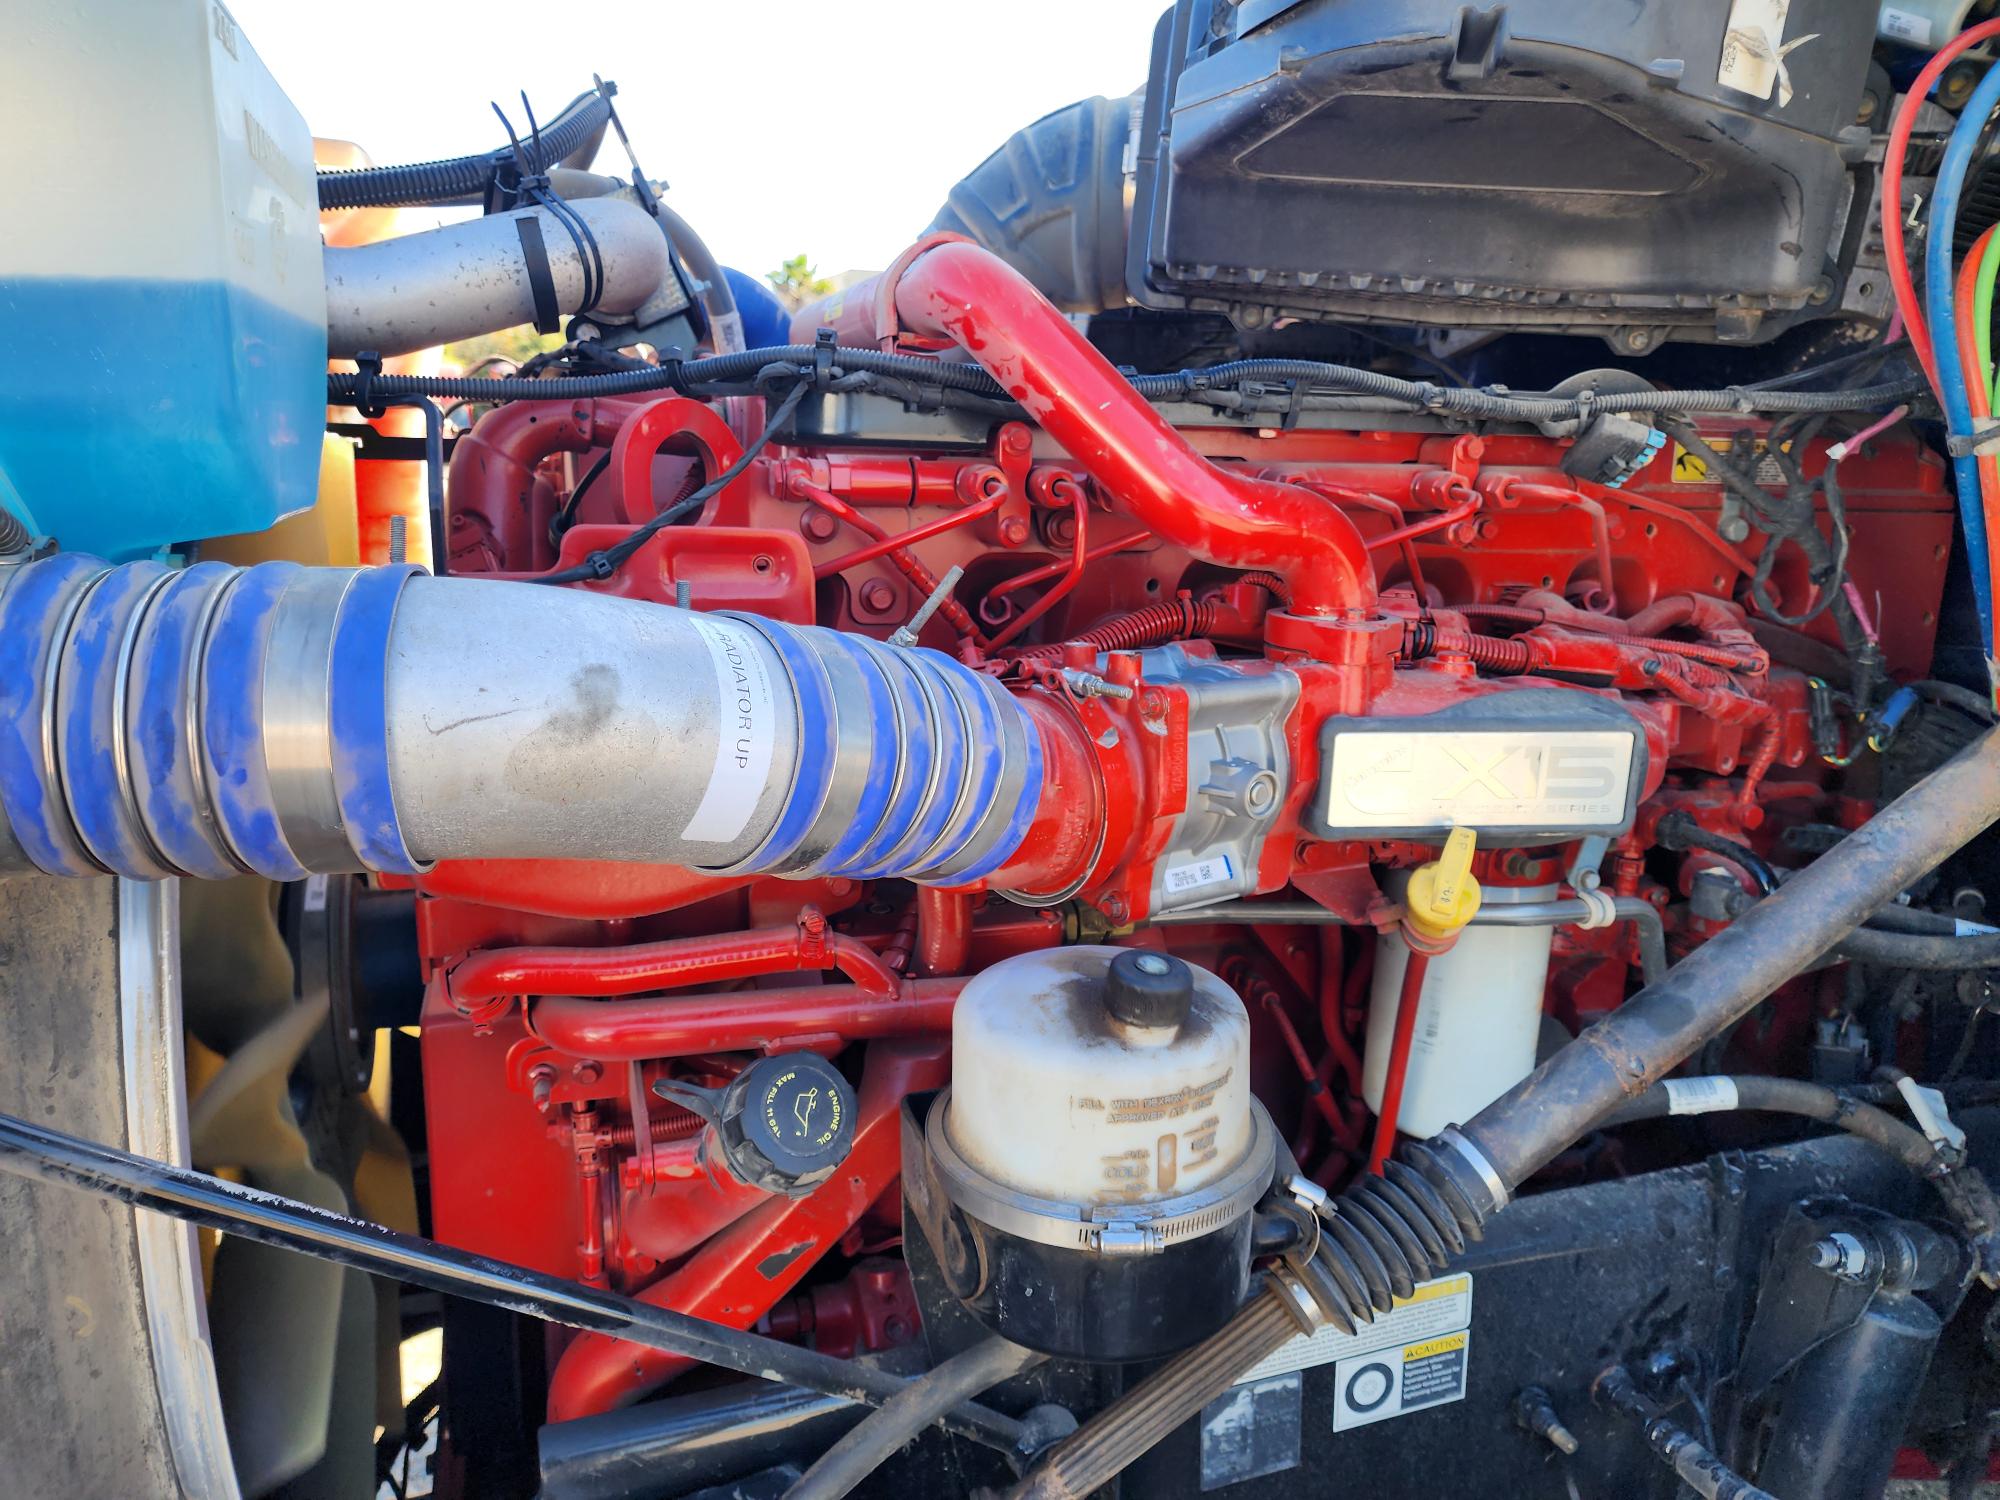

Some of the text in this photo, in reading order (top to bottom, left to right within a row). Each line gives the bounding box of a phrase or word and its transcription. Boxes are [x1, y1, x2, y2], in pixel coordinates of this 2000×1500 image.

[716, 631, 753, 769] RADIATOR UP
[1432, 745, 1615, 800] X15
[766, 1072, 796, 1138] MAX FILL 11 GAL
[816, 1089, 841, 1145] ENGINE OIL
[1111, 1098, 1139, 1110] WITH
[1415, 1337, 1465, 1356] CAUTION
